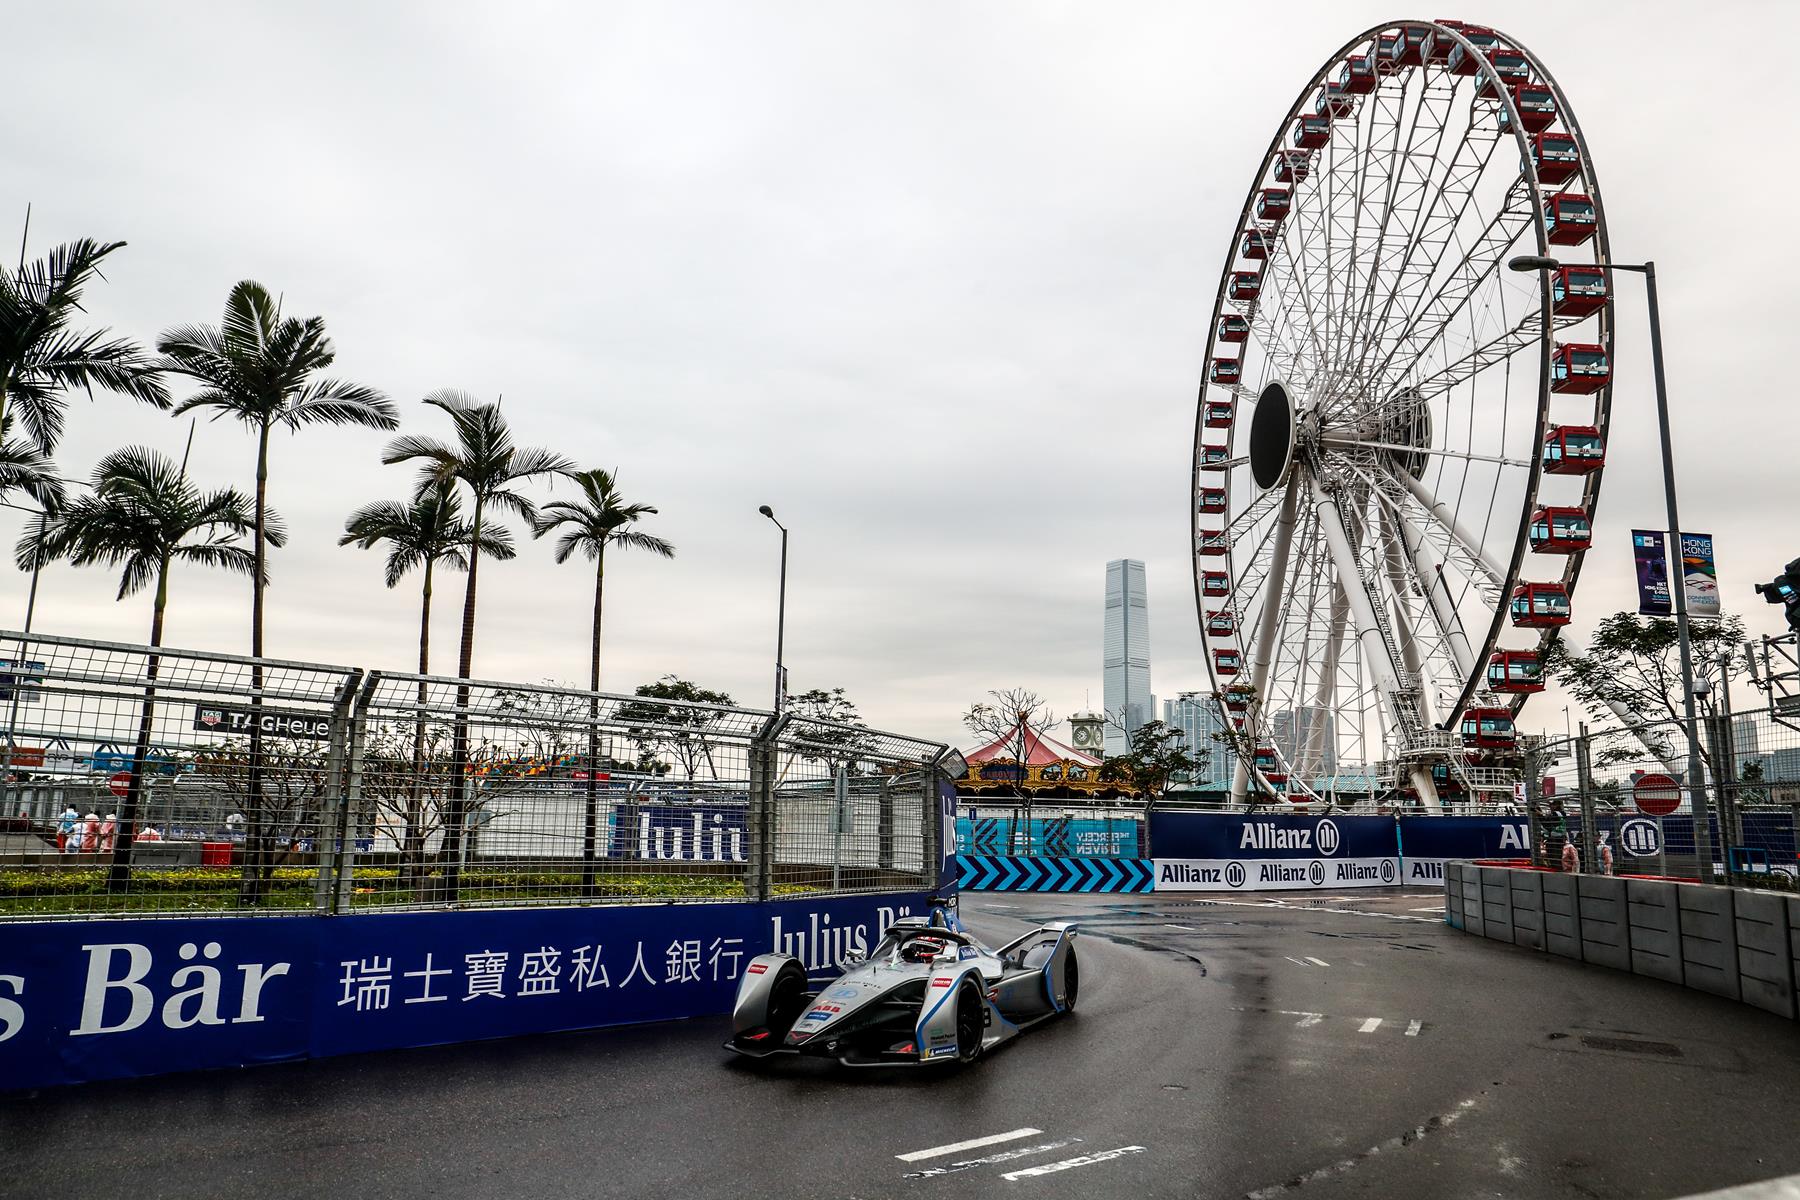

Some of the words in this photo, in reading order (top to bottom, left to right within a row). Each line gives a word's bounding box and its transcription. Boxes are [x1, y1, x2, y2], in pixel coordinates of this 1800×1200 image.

[1682, 540, 1710, 548] HONG
[1684, 546, 1712, 555] KONG
[1240, 822, 1312, 849] Allianz
[1161, 864, 1221, 883] Allianz
[1260, 864, 1306, 882] Allianz
[1336, 863, 1378, 880] Allianz
[1412, 862, 1442, 878] Alli
[772, 913, 868, 972] Julius
[337, 936, 744, 1012] 瑞士寶盛私人銀行
[69, 942, 291, 1036] Bär
